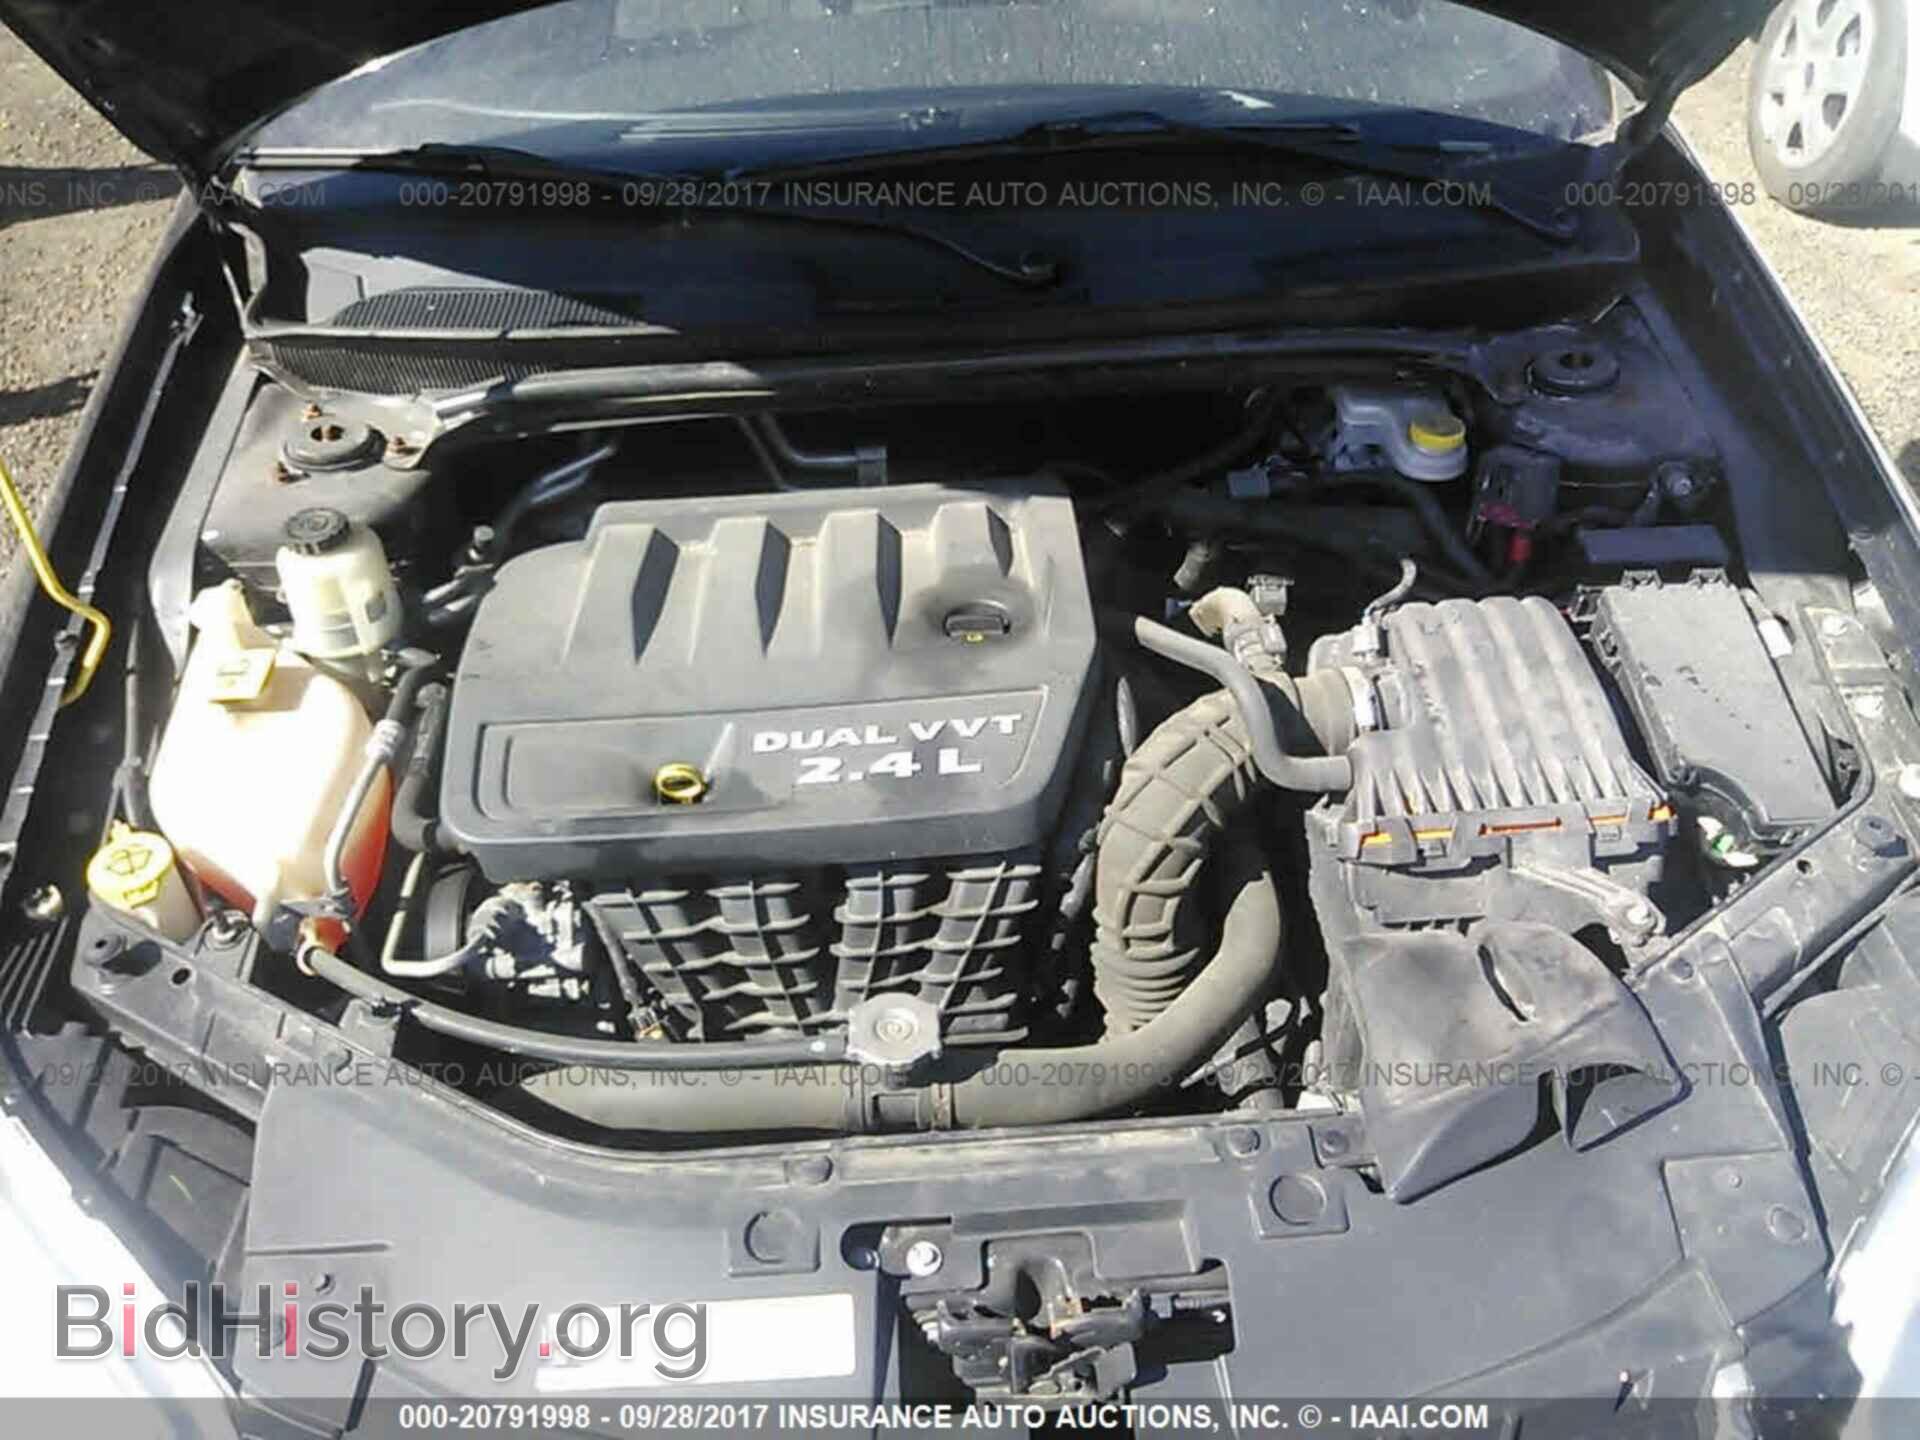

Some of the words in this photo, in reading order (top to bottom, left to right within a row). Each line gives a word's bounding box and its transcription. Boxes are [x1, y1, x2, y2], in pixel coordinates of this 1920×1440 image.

[752, 724, 899, 752] DUAL
[908, 713, 1023, 741] VVT
[796, 751, 922, 785] 2.4
[937, 747, 984, 775] L
